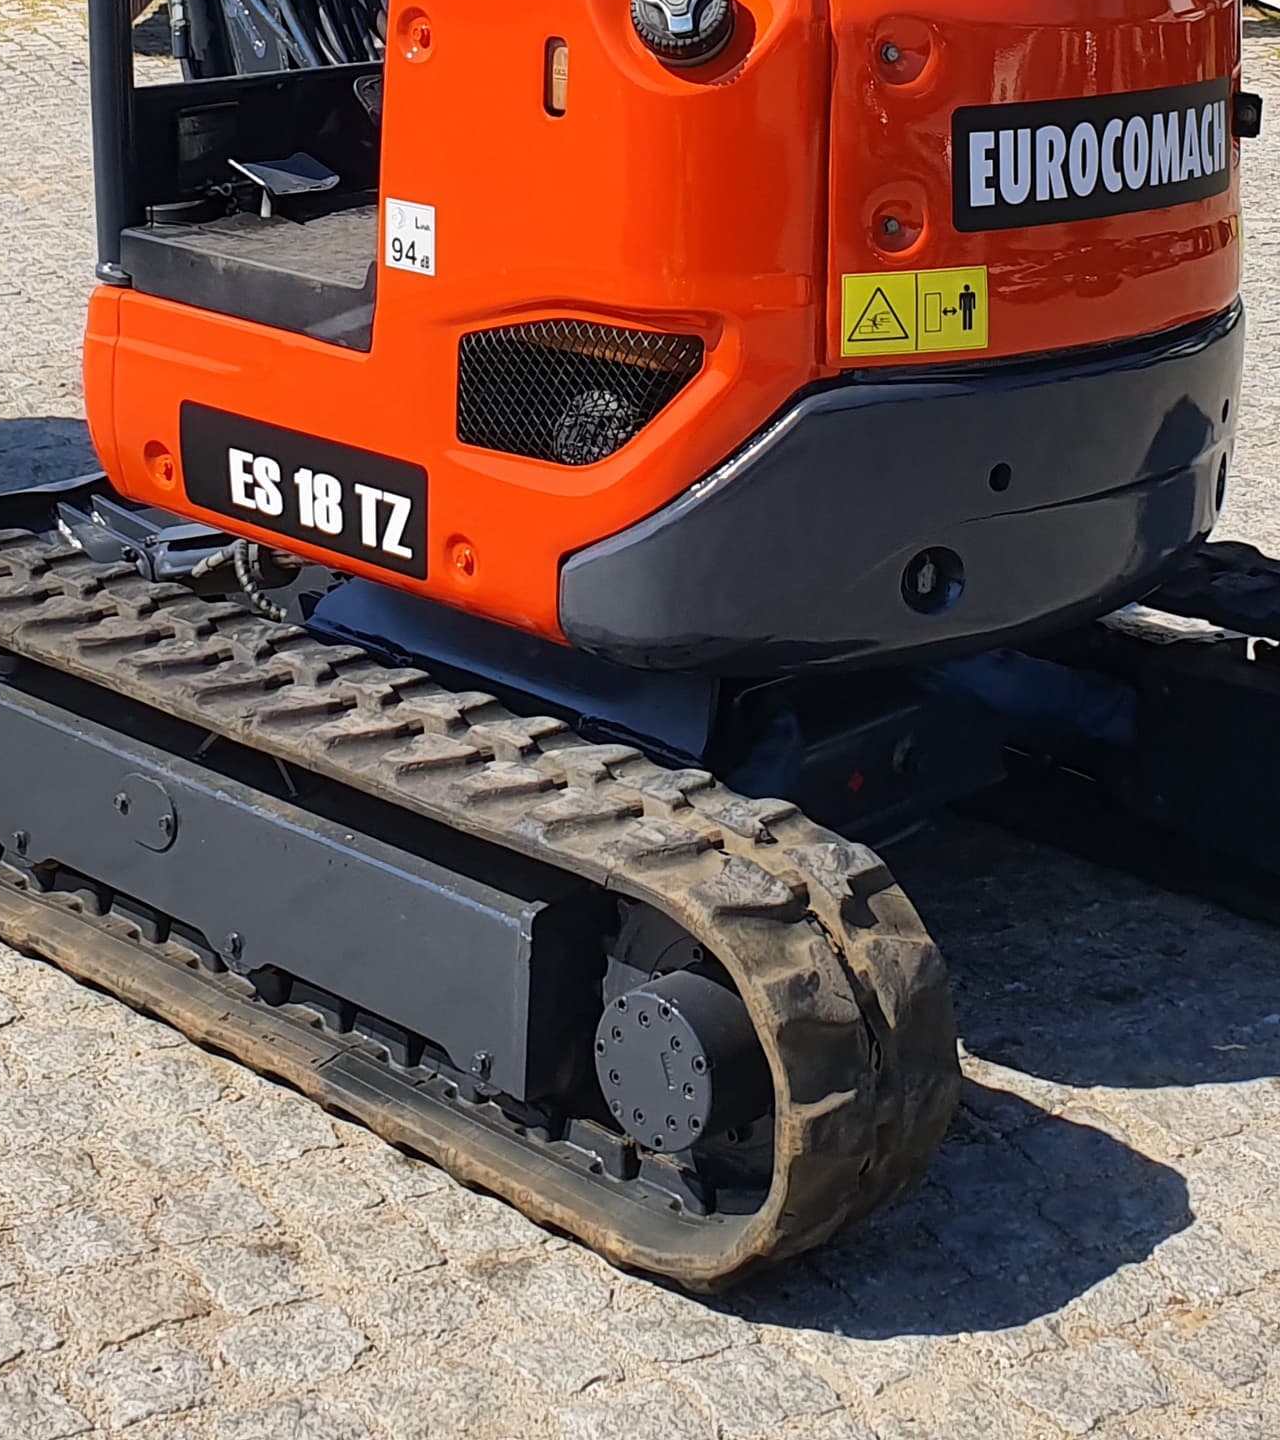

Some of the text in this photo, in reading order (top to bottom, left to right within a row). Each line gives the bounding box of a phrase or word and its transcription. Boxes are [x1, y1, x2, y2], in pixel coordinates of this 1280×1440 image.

[969, 100, 1226, 207] EUROCOMACH
[392, 237, 417, 266] 94
[228, 447, 413, 559] ES 18 TZ
